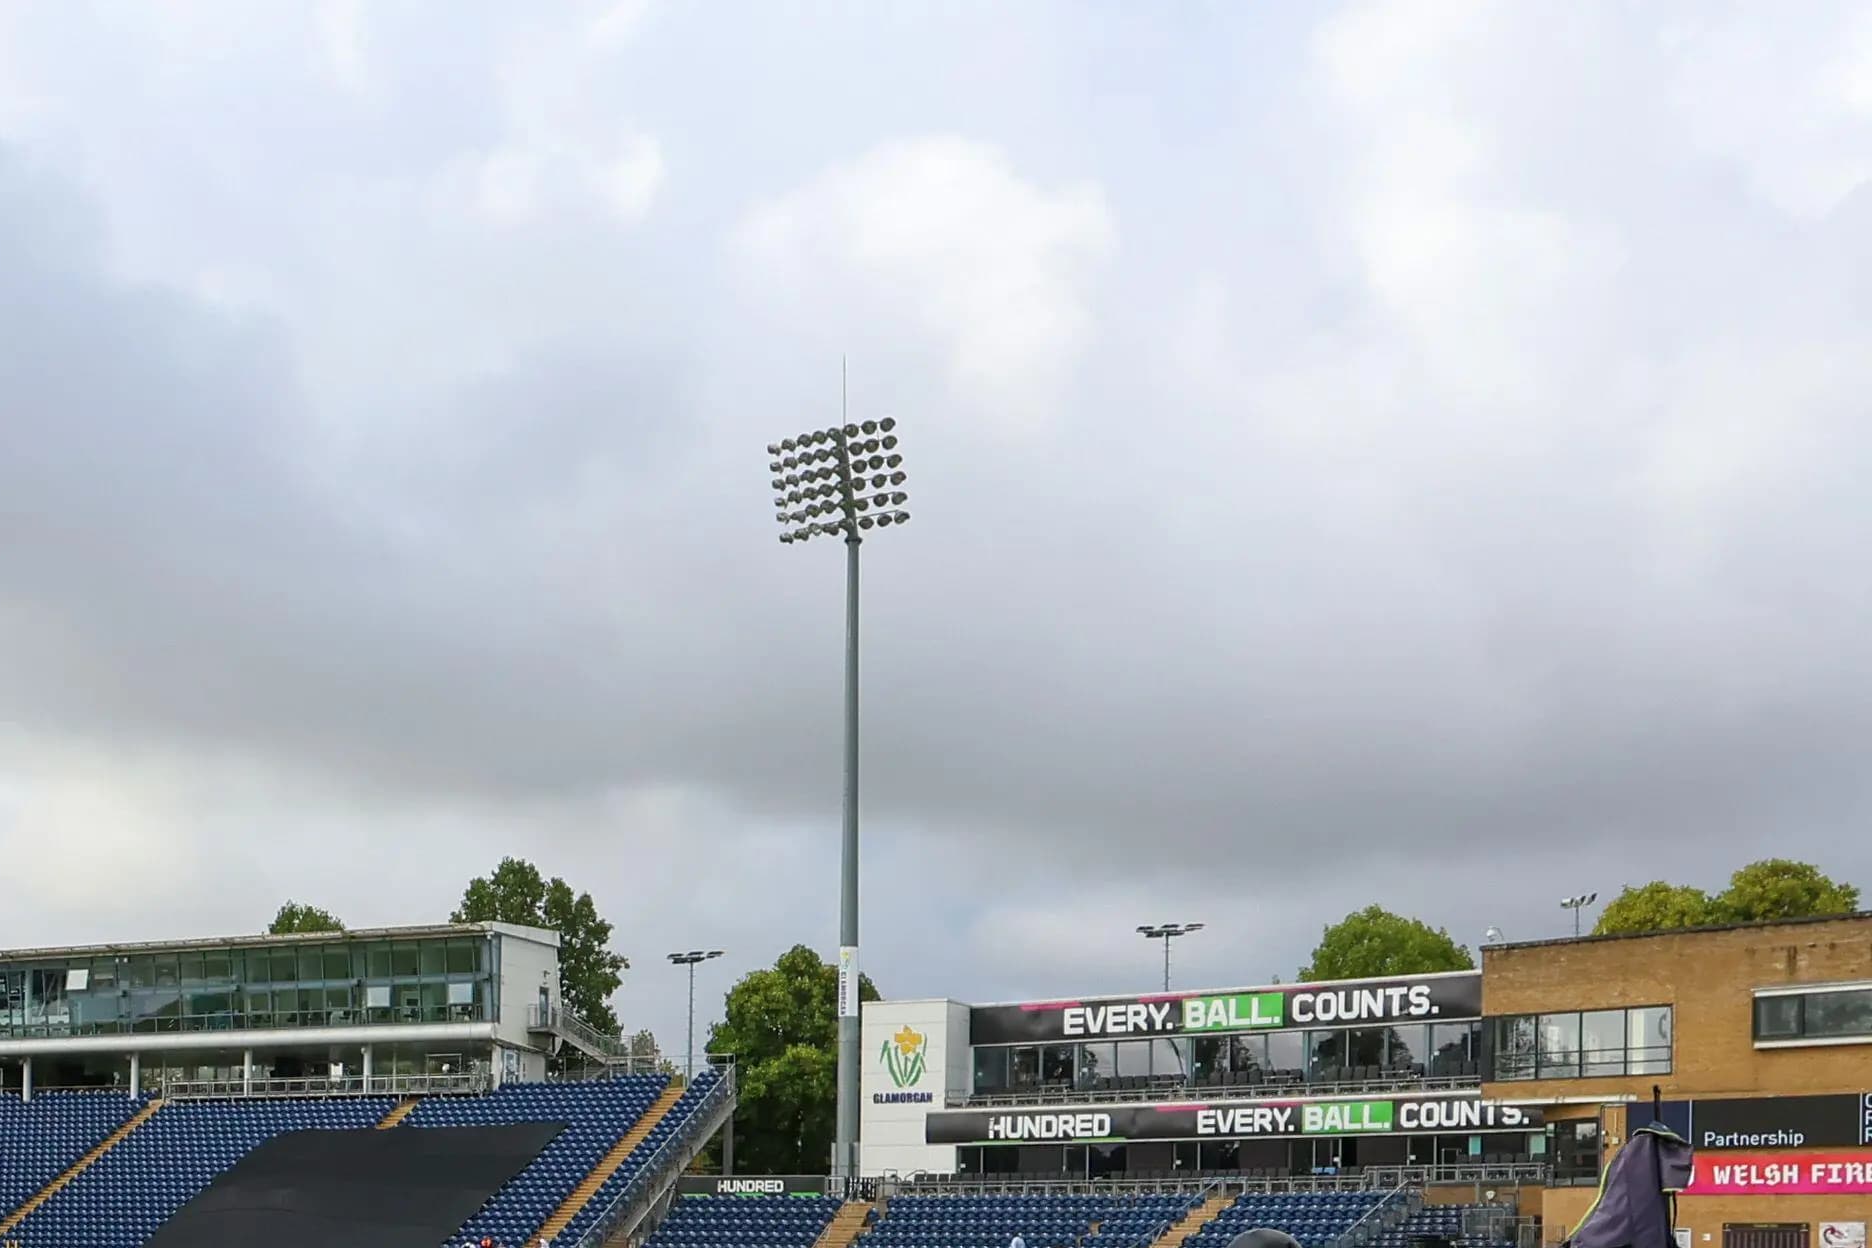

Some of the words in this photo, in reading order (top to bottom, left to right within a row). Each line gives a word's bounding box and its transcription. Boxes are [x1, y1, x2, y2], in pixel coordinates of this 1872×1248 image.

[1063, 1002, 1173, 1035] EVERY.
[1184, 997, 1281, 1028] BALL.
[1292, 985, 1439, 1023] COUNTS.
[873, 1092, 933, 1104] GLAMORGAN
[989, 1113, 1111, 1139] HUNDRED
[1197, 1107, 1295, 1134] EVERY.
[1305, 1104, 1390, 1130] BALL.
[1704, 1129, 1804, 1147] Partnership
[1713, 1163, 1799, 1186] WELSH
[717, 1180, 784, 1193] HUNDRED
